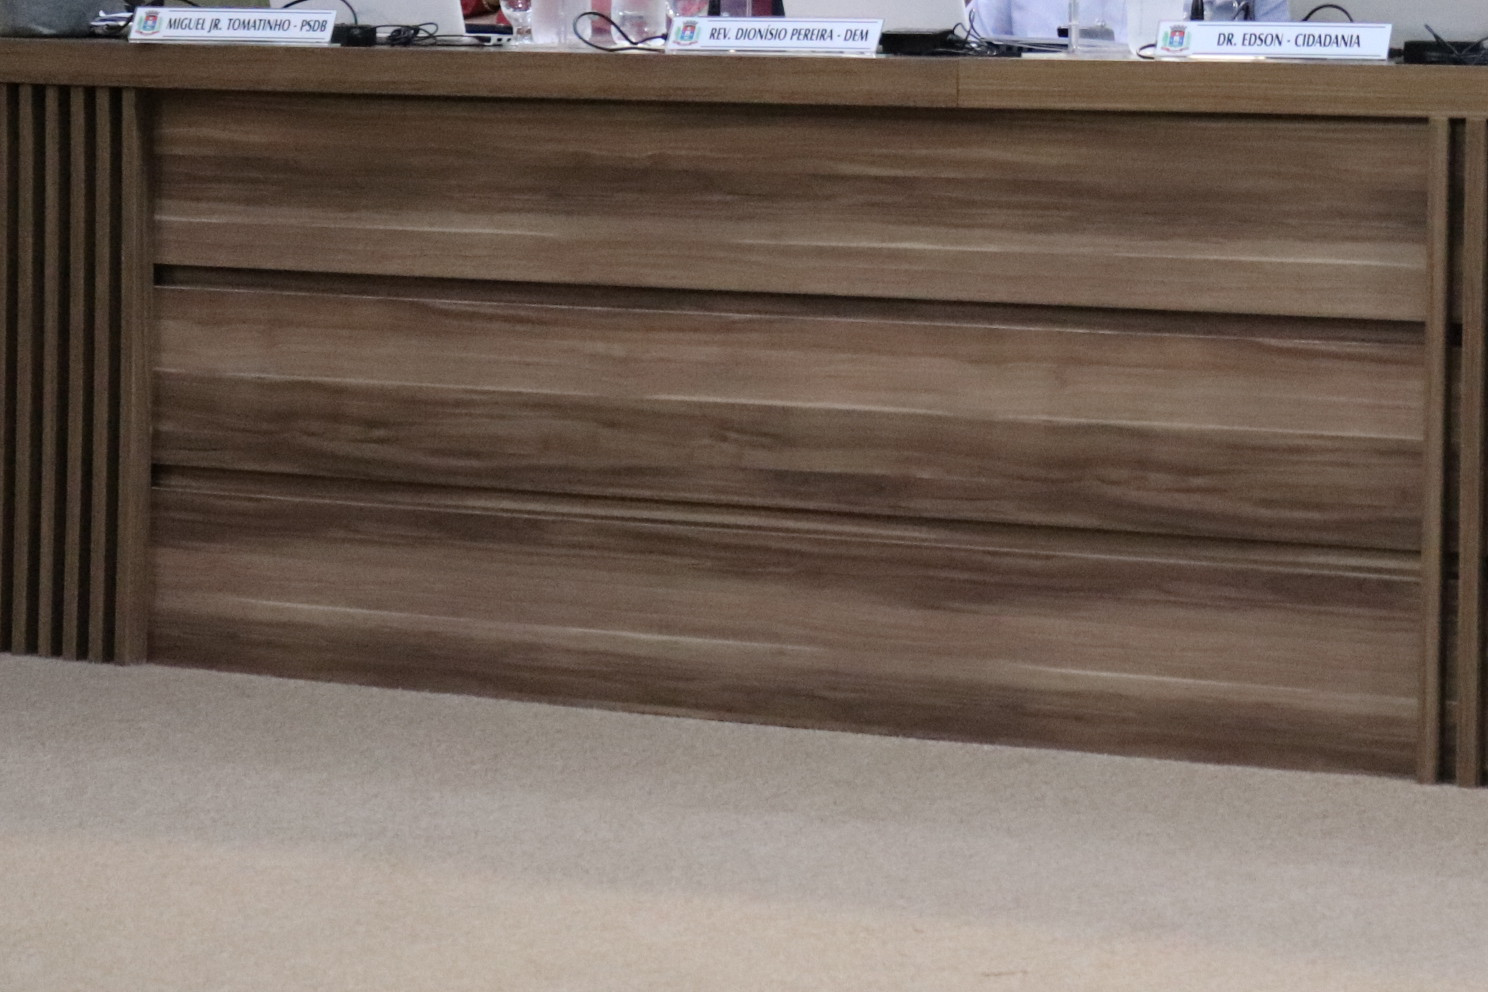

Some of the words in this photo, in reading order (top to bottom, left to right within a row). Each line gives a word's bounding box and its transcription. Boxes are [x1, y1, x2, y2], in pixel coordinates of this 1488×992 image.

[166, 17, 206, 31] MIGUEL
[207, 18, 222, 33] JR.
[227, 18, 291, 32] TOMATINHO
[300, 19, 328, 33] PSDB
[709, 27, 731, 40] REV.
[735, 23, 788, 41] DIONÍSIO
[790, 28, 833, 41] PEREIRA
[843, 29, 869, 42] DEM
[1217, 32, 1237, 47] DR.
[1241, 33, 1284, 47] EDSON
[1294, 33, 1361, 48] CIDADANIA
